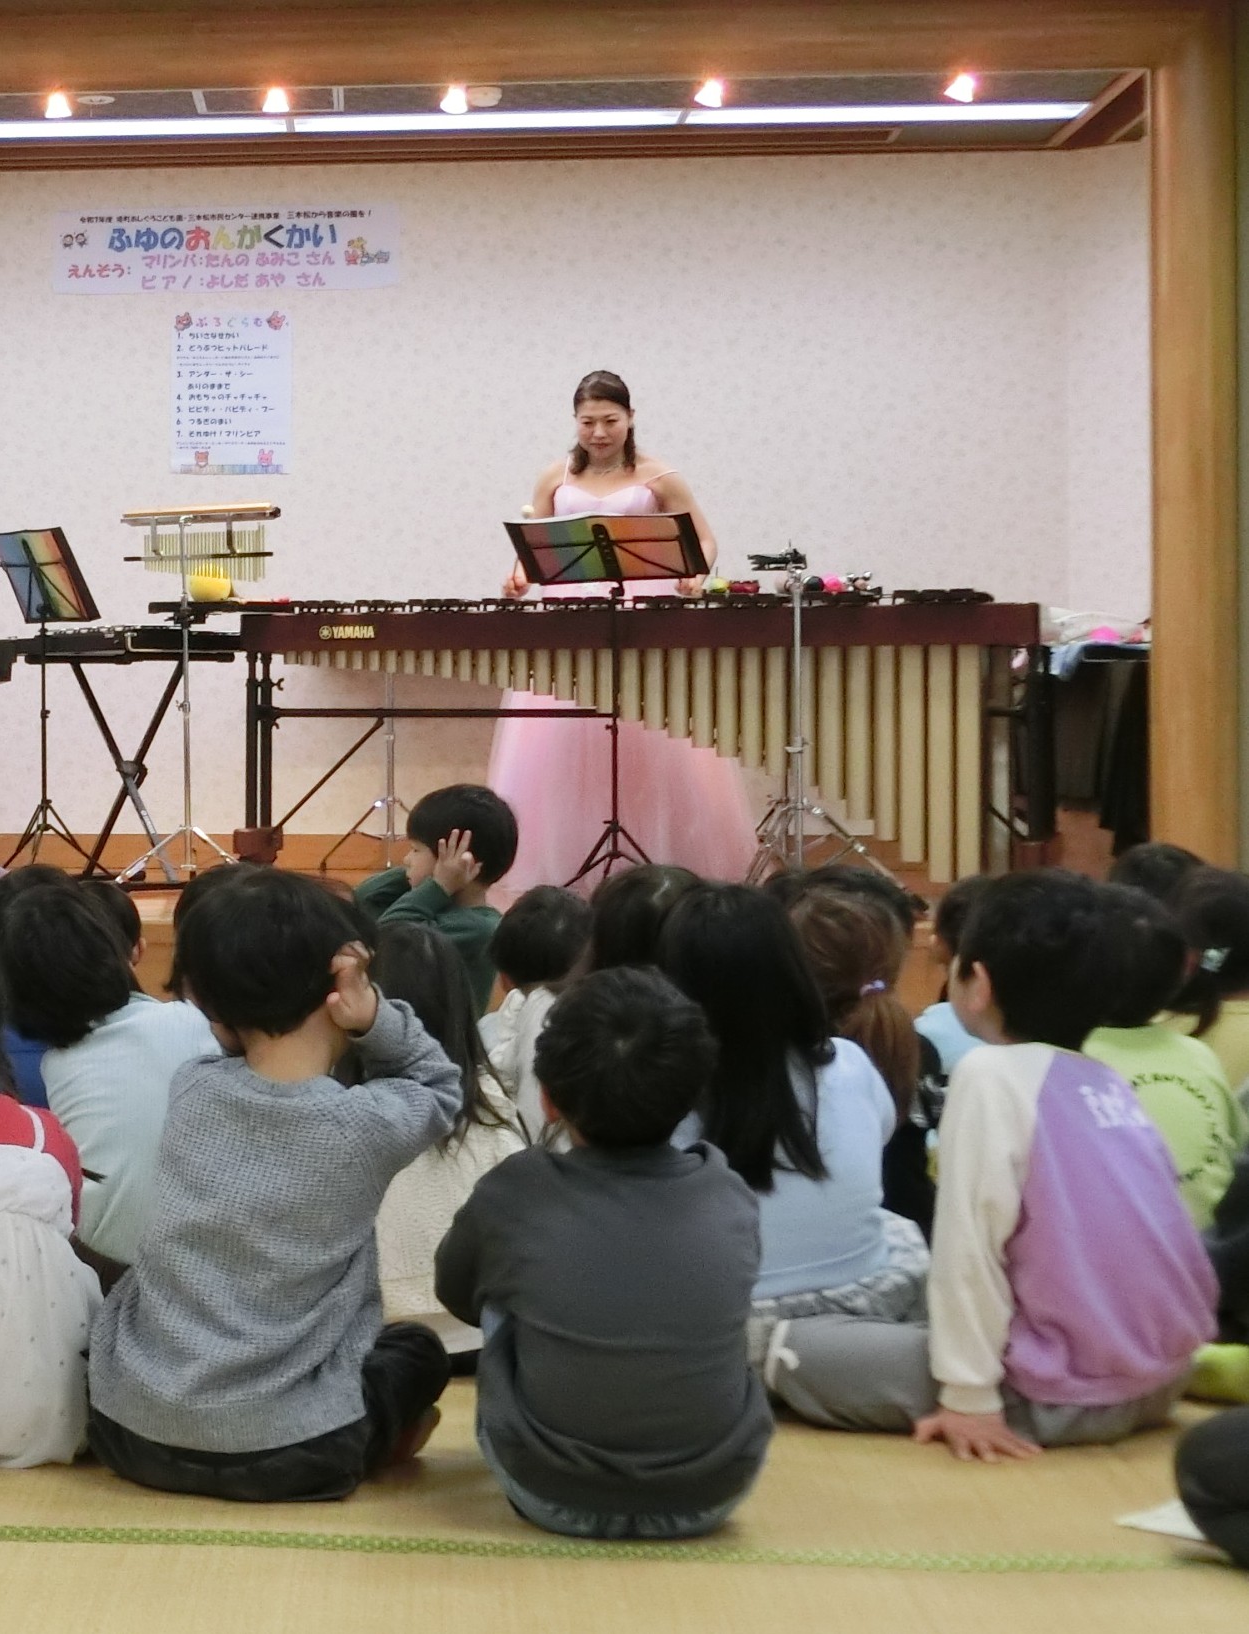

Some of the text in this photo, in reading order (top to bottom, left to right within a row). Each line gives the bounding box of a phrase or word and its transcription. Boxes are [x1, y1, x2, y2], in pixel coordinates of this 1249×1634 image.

[108, 223, 337, 252] ふゆのおんがくかい
[306, 251, 335, 266] さん
[255, 273, 286, 288] あや
[296, 272, 326, 287] さん
[332, 626, 375, 639] YAMAHA
